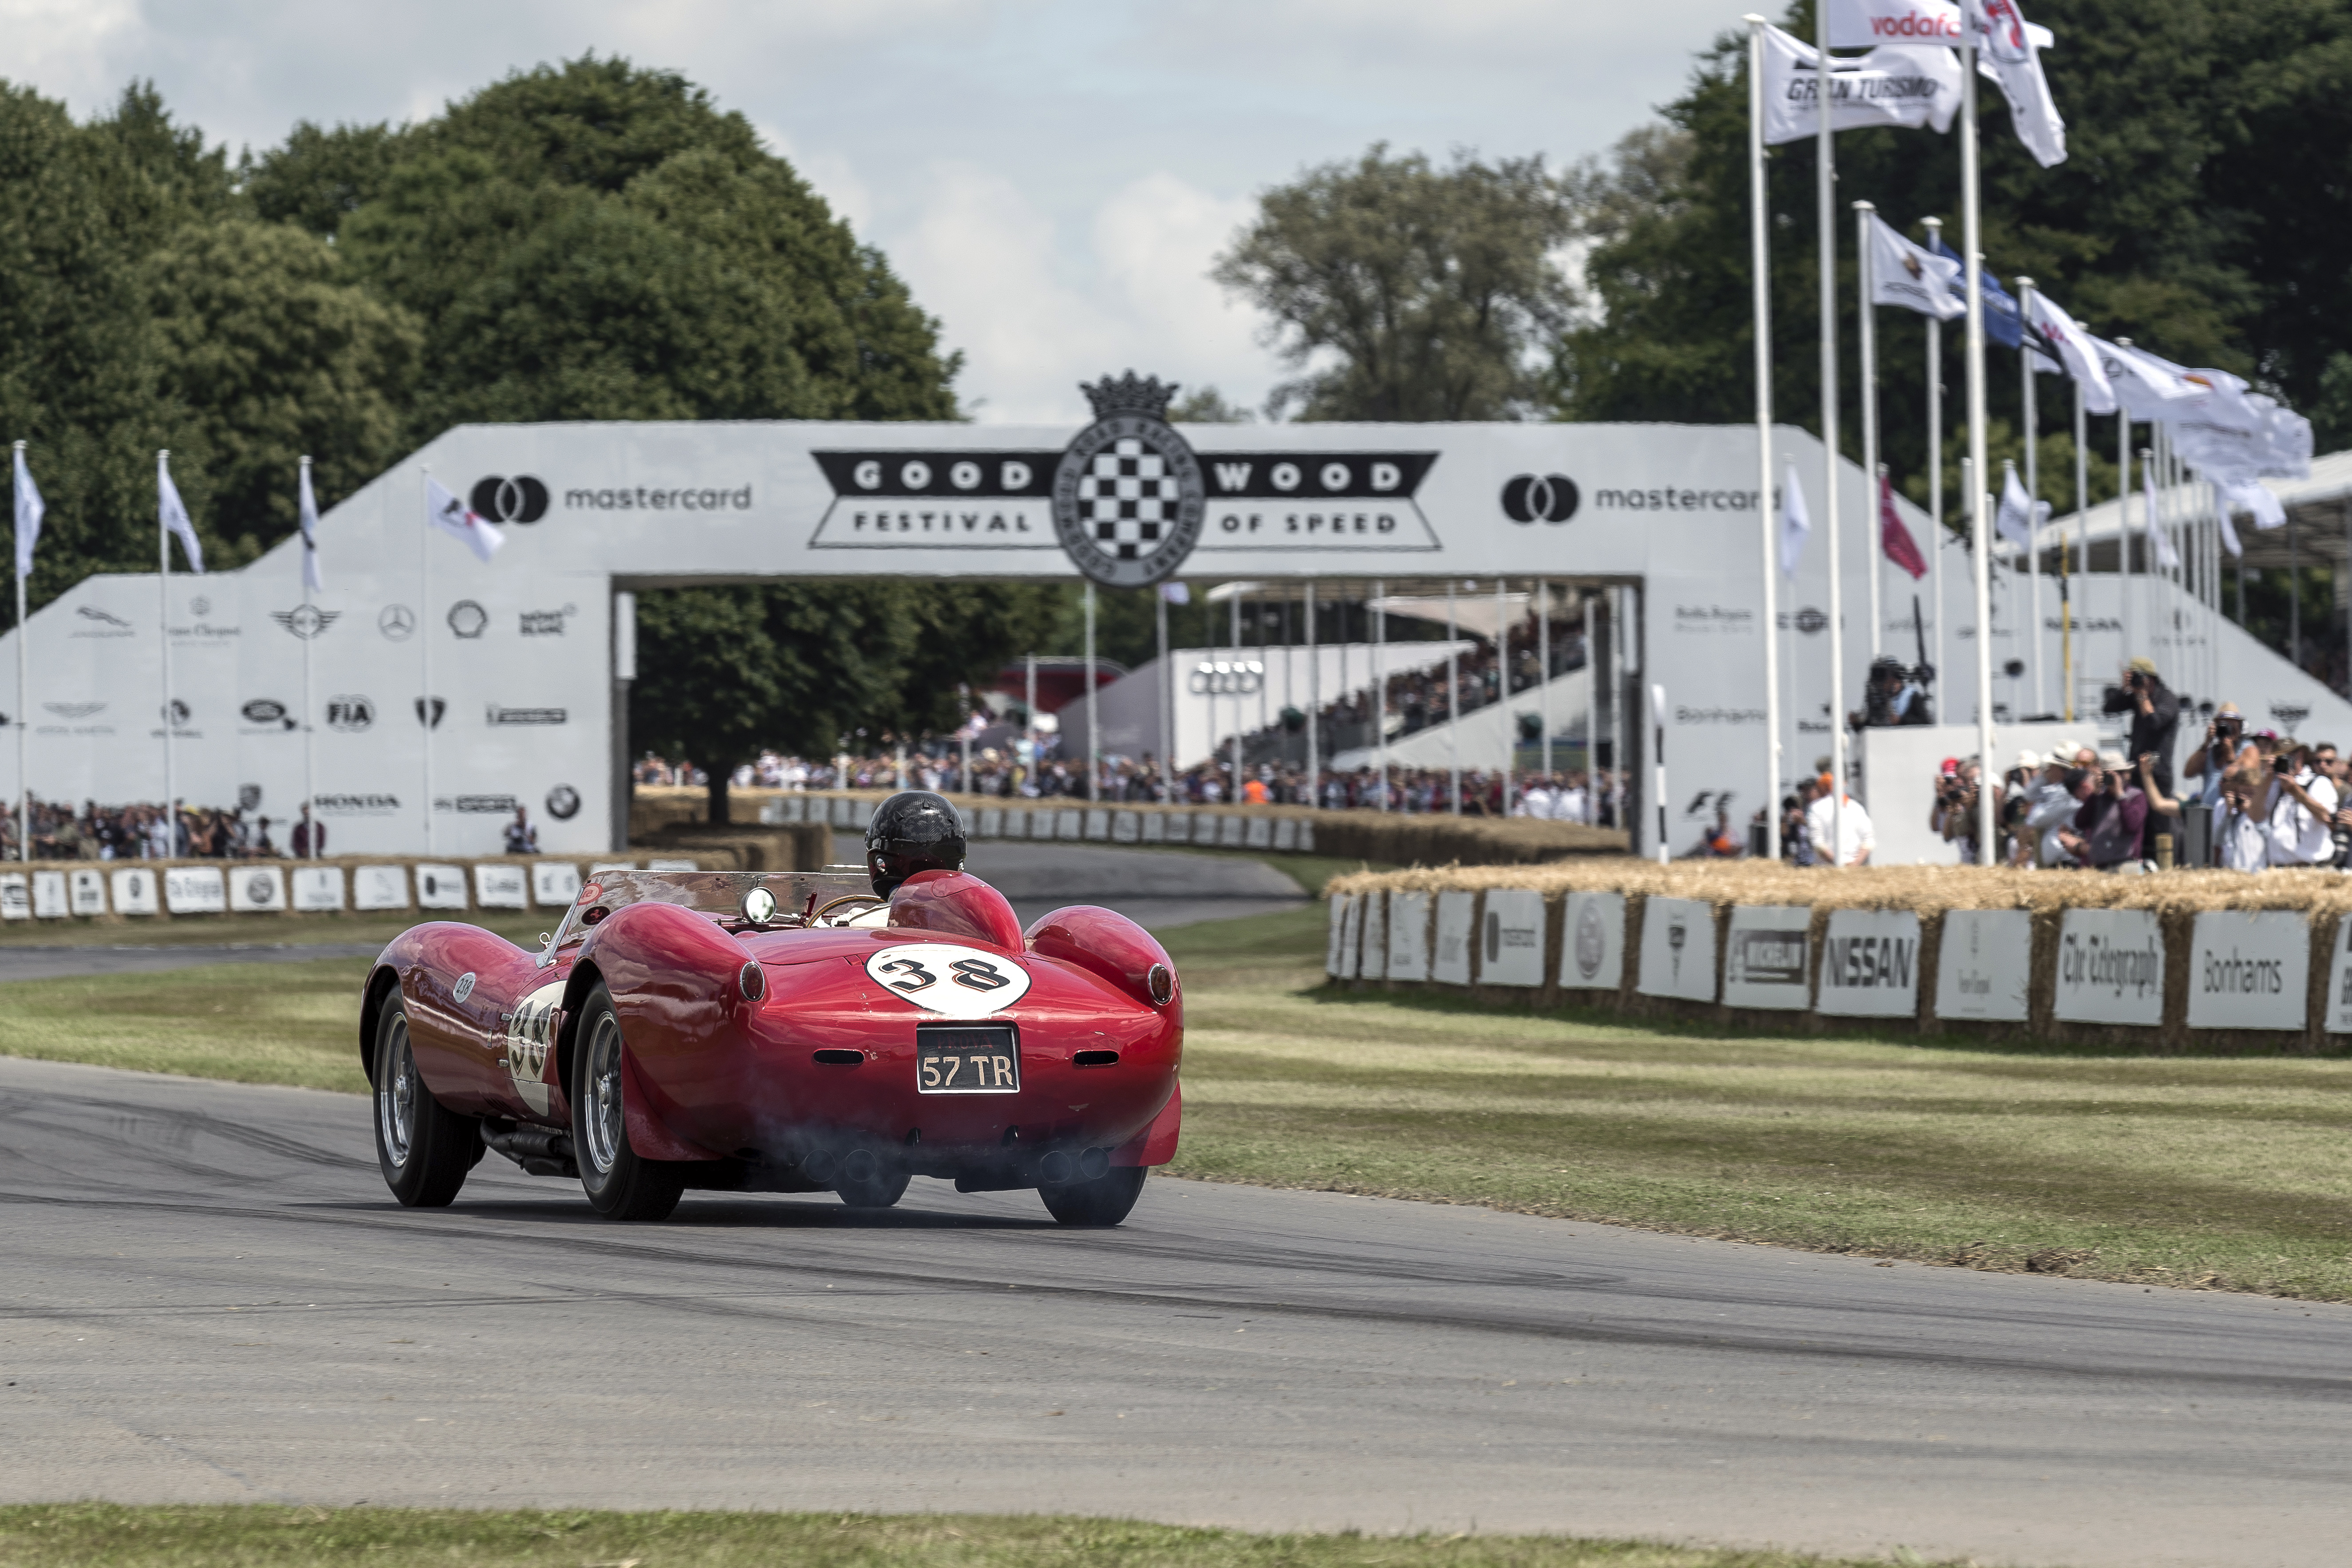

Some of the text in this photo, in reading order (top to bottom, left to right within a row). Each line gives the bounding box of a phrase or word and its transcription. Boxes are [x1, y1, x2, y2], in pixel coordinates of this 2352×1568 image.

[1871, 10, 1990, 37] vodafo
[1787, 78, 1851, 100] GRN
[852, 460, 1403, 491] GOOD WOOD
[564, 482, 752, 510] mastercard
[853, 512, 1397, 534] FESTIVAL OF SPEED
[327, 703, 370, 725] FIA
[1676, 705, 1767, 725] Bonham
[312, 795, 400, 808] HONDA
[1825, 937, 1914, 988] NISSAN
[2089, 934, 2158, 999] Telegraph
[2204, 946, 2282, 994] Bonhams
[456, 977, 473, 995] 238
[878, 959, 1011, 994] 38
[511, 1000, 554, 1078] 38
[937, 1034, 994, 1049] PROVA
[923, 1055, 1014, 1086] 57 TR
